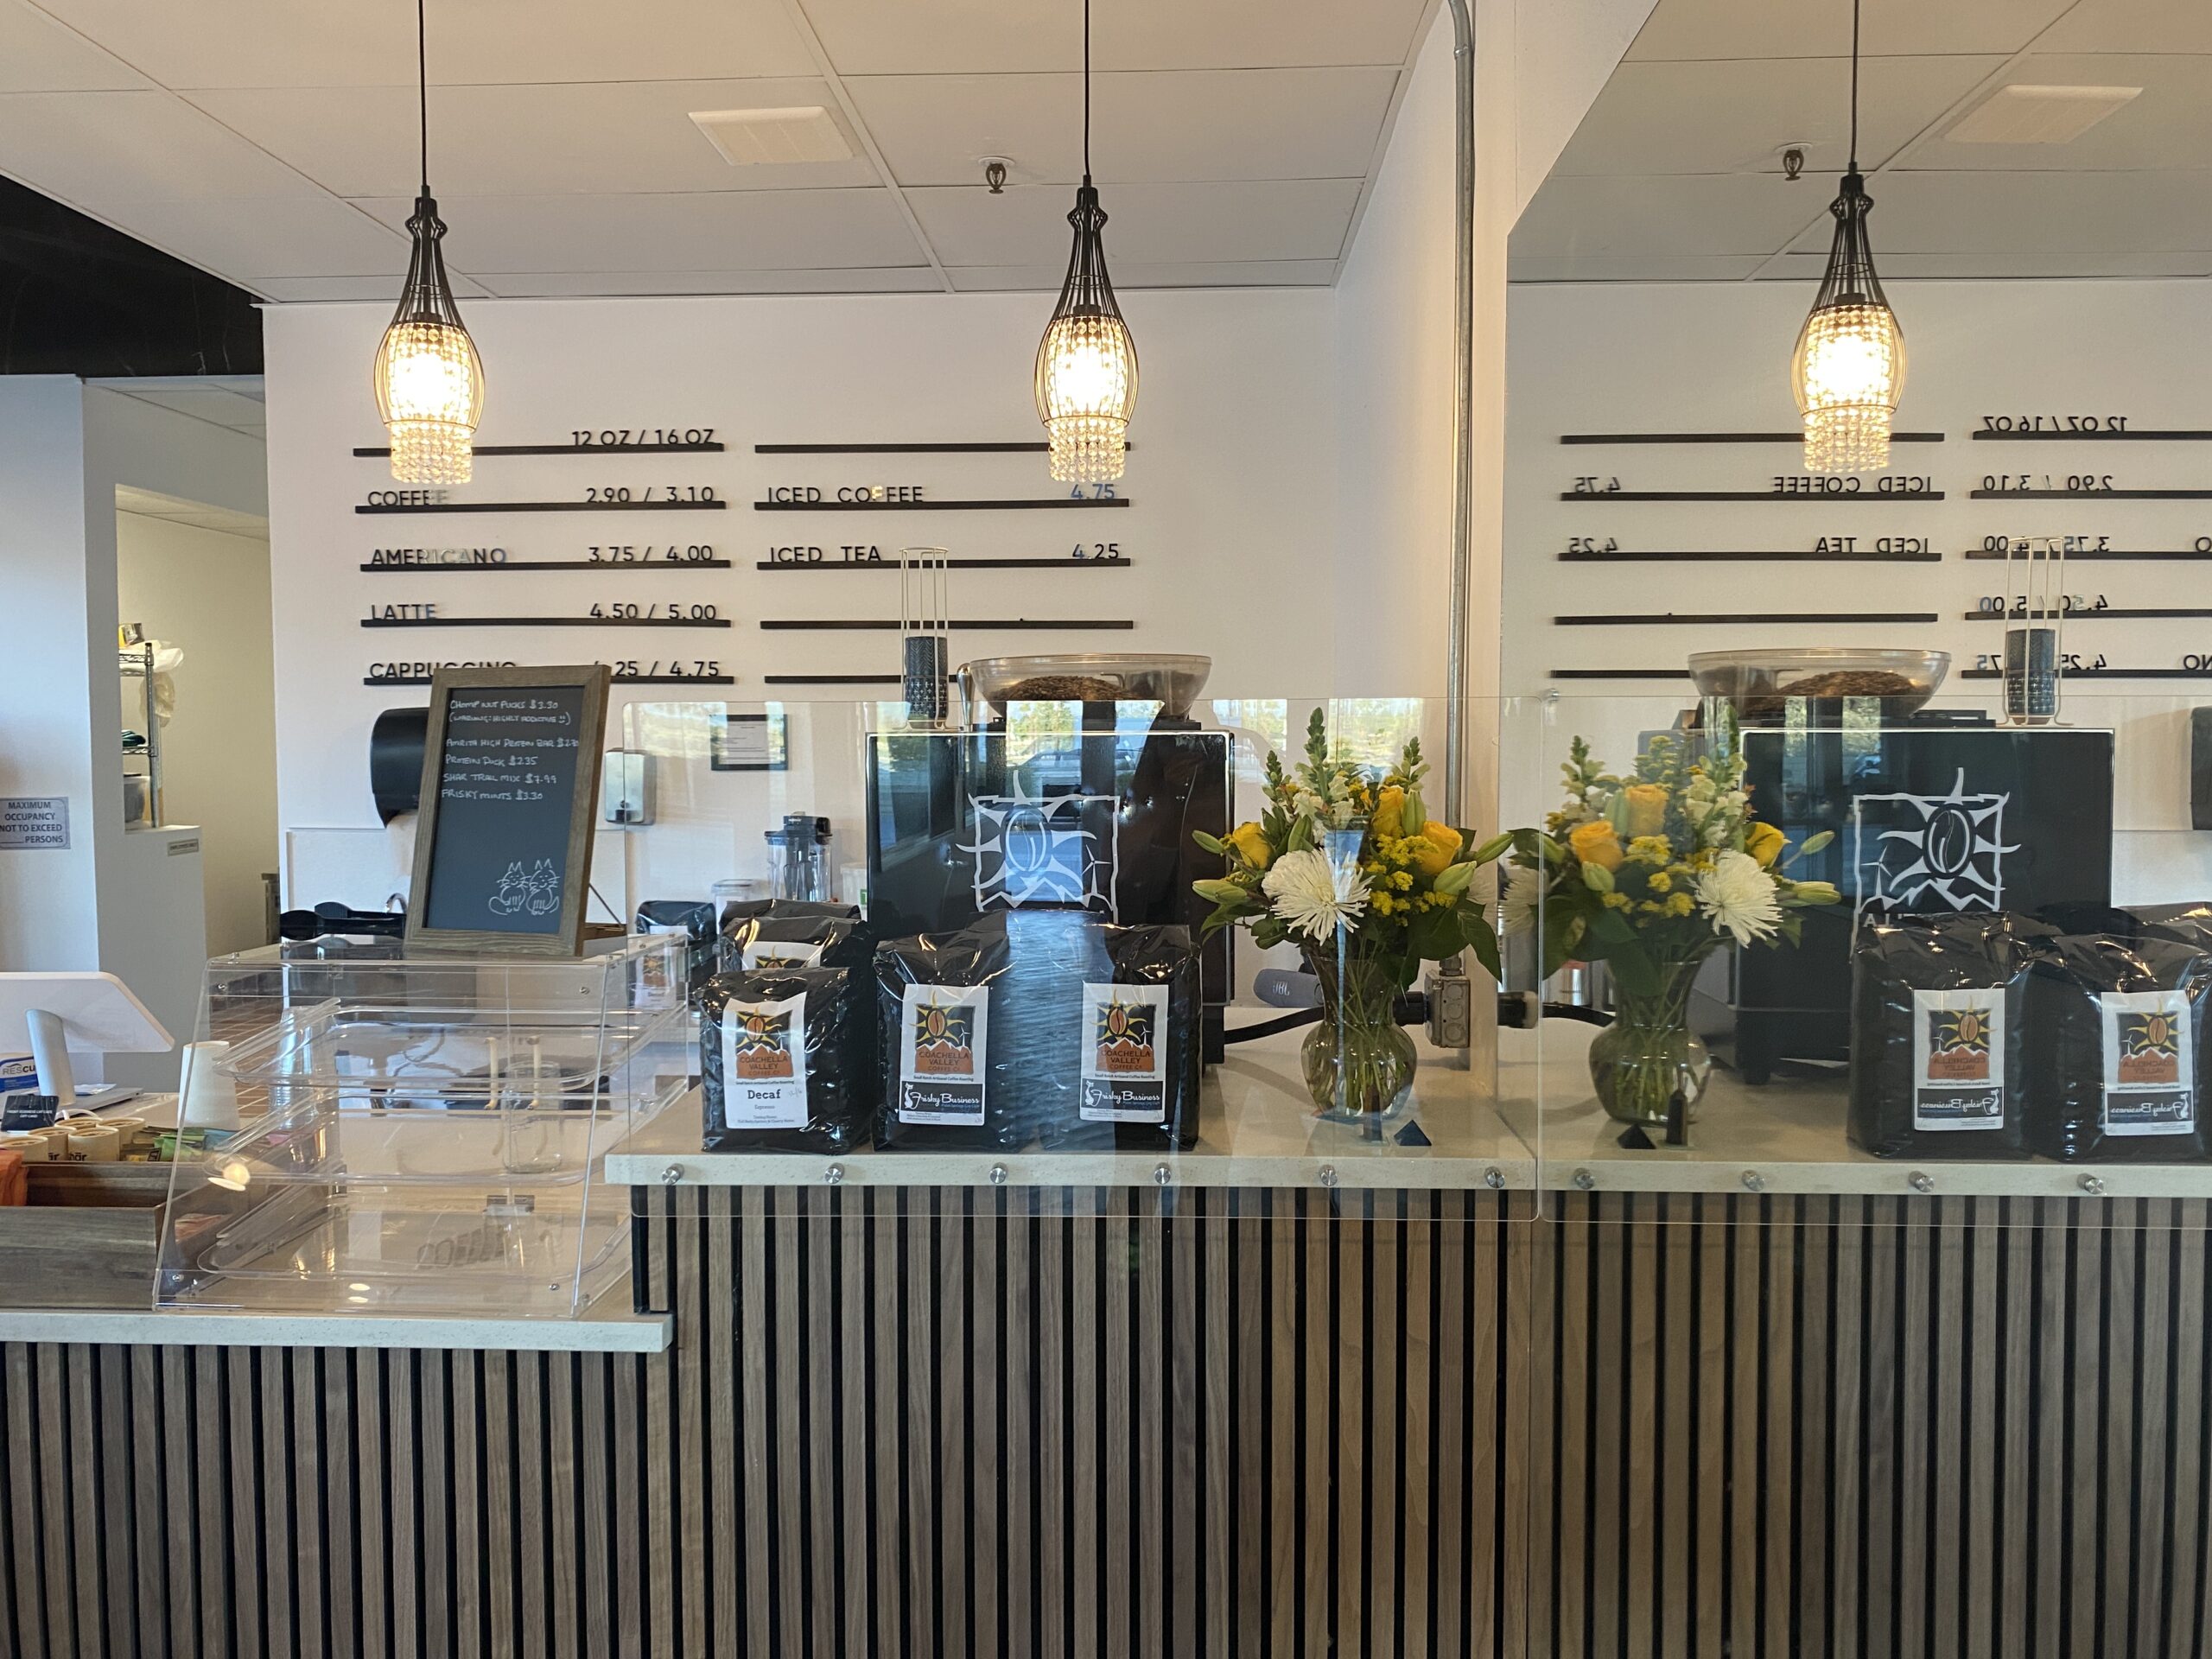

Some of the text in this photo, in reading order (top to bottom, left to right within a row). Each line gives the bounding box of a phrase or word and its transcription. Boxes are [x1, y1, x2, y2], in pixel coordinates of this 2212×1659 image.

[572, 430, 592, 446] 12
[600, 429, 630, 445] OZ
[655, 429, 678, 444] 16
[685, 429, 715, 444] OZ
[367, 490, 449, 506] COFFEE
[586, 487, 630, 504] 2.90
[666, 486, 714, 503] 3.10
[768, 484, 1116, 503] ICED COFFEE 4.75
[372, 548, 506, 564] AMERICANO
[588, 547, 634, 563] 3.75
[666, 546, 714, 562] 4.00
[771, 543, 1119, 563] ICED TEA 4.25
[371, 604, 435, 620] LATTE
[590, 603, 638, 620] 4.50
[668, 604, 716, 620] 5.00
[670, 661, 720, 677] 4.75
[442, 789, 478, 799] FRISKY
[515, 789, 543, 800] $3.30
[8, 801, 51, 810] MAXIMUM
[4, 812, 55, 821] OCCUPANCY
[30, 823, 62, 832] EXCEED
[24, 836, 63, 844] PERSONS
[1272, 982, 1290, 996] JBL
[747, 1089, 781, 1099] Decaf
[909, 1091, 980, 1109] Frisky Business
[1090, 1089, 1160, 1106] Frisky Business
